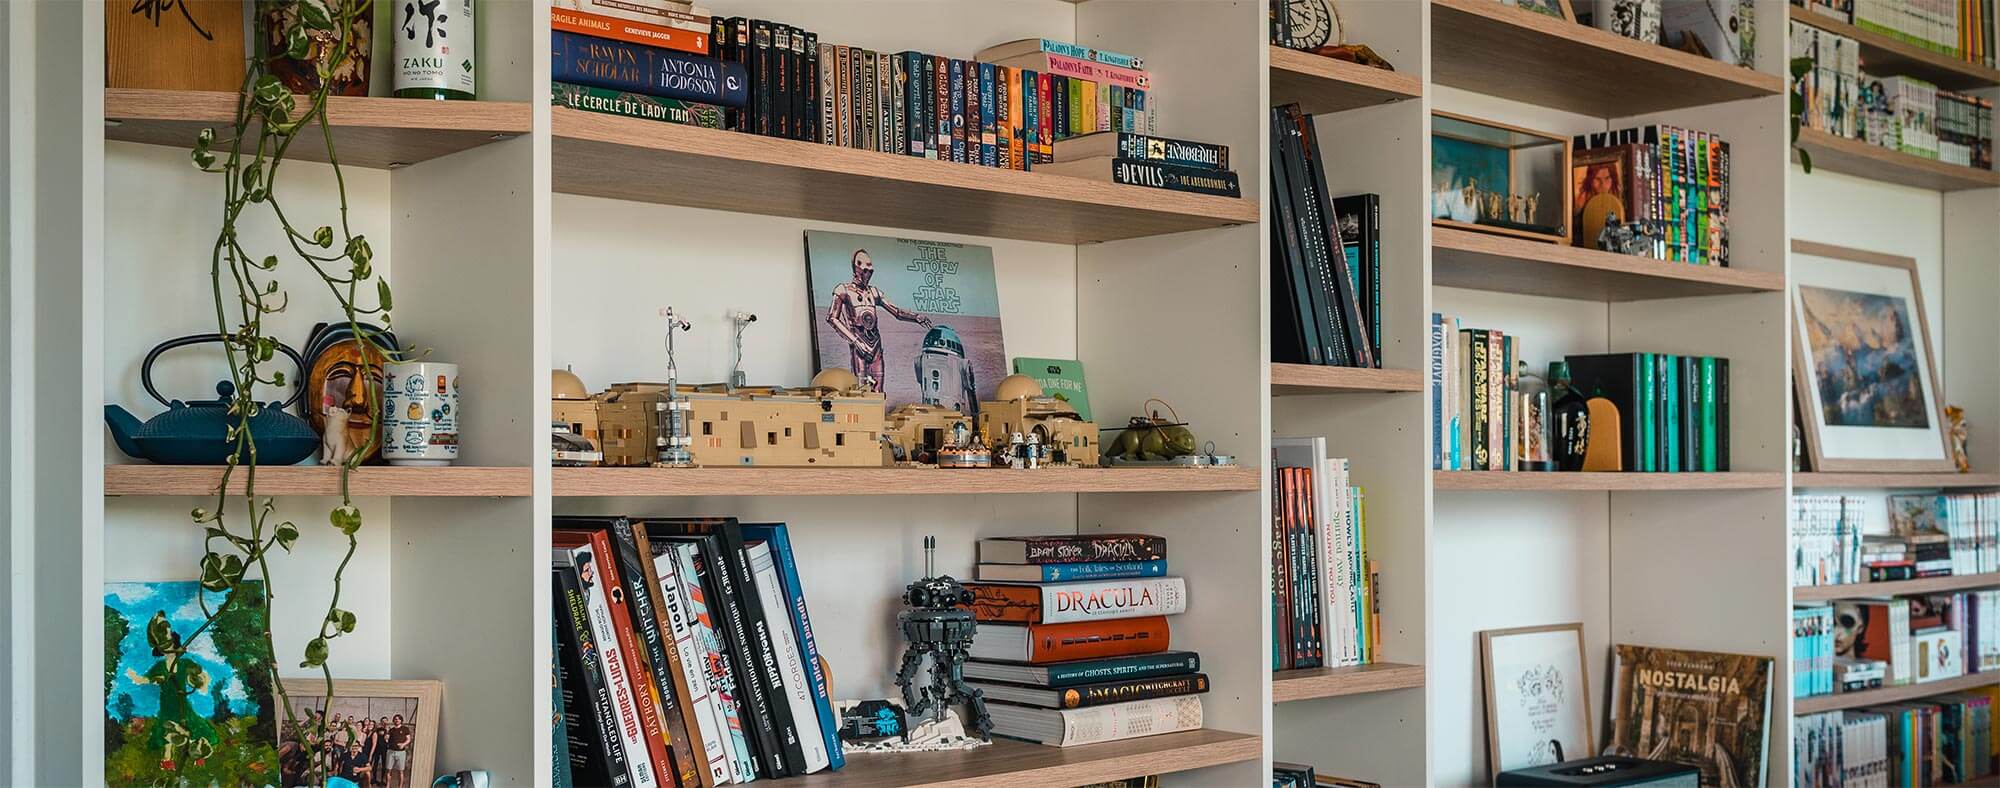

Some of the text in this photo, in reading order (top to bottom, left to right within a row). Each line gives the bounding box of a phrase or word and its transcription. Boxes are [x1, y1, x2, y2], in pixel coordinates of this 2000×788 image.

[551, 12, 611, 31] RAGILE ANIMALS
[624, 26, 671, 41] GENEVIEVE JAGGER
[589, 43, 637, 65] RAVEN
[1043, 39, 1085, 58] PALADIN'S HOPE
[1104, 54, 1130, 66] KINGFISHER
[403, 57, 443, 69] ZAKU
[575, 58, 641, 82] SCHOLAR
[660, 58, 716, 80] ANTONIA
[912, 59, 921, 78] DEAD
[1050, 58, 1094, 76] PALADIN'S FAITH
[660, 72, 717, 95] HODGSON
[854, 60, 862, 107] BLACKWATER
[1110, 72, 1134, 84] KINGFISHER
[568, 93, 689, 123] LE CERCLE DE LADY TAN
[865, 67, 874, 128] BLACKWATER IV
[938, 74, 949, 121] CLUB DEAD
[1167, 142, 1218, 166] FIREBORNE
[1122, 164, 1164, 188] DEVILS
[1180, 174, 1227, 191] JOE ABERCROMBIE
[918, 246, 947, 260] THE
[907, 259, 959, 274] STORY
[925, 273, 944, 287] OF
[913, 286, 961, 301] STAR
[914, 299, 961, 314] WARS
[1073, 381, 1082, 392] ME
[1029, 540, 1138, 559] BRAM STOKER DRACULA
[1333, 512, 1344, 588] Spirited Away
[718, 556, 731, 586] Monde
[1116, 562, 1144, 572] Scotland
[1328, 566, 1336, 606] TOULON
[567, 588, 584, 631] SHELDRAKE
[576, 594, 587, 622] MERLIN
[633, 577, 658, 646] WITCHER
[664, 584, 684, 633] Japon
[1055, 587, 1153, 615] DRACULA
[730, 600, 746, 646] NORDIQUE
[661, 619, 679, 663] RAPTOR
[797, 596, 826, 698] un pied au paradis
[606, 648, 624, 686] LUCAS
[652, 648, 660, 662] THE
[684, 646, 688, 658] La
[690, 669, 696, 678] en
[658, 667, 664, 676] DE
[703, 656, 717, 693] Friday
[713, 658, 728, 692] Friday
[722, 653, 737, 691] Friday
[742, 646, 762, 702] MYTHOLOGIE
[1084, 667, 1112, 678] GHOSTS,
[1112, 665, 1138, 676] SPIRITS
[1640, 668, 1741, 696] NOSTALGIA
[660, 677, 672, 700] MONDE
[1145, 680, 1190, 690] WITCHCRAFT
[616, 687, 638, 738] GUERRES
[639, 683, 659, 737] BÁTHORY
[667, 700, 674, 710] LE
[758, 702, 766, 718] LA
[598, 688, 623, 764] ENTANGLED LIFE
